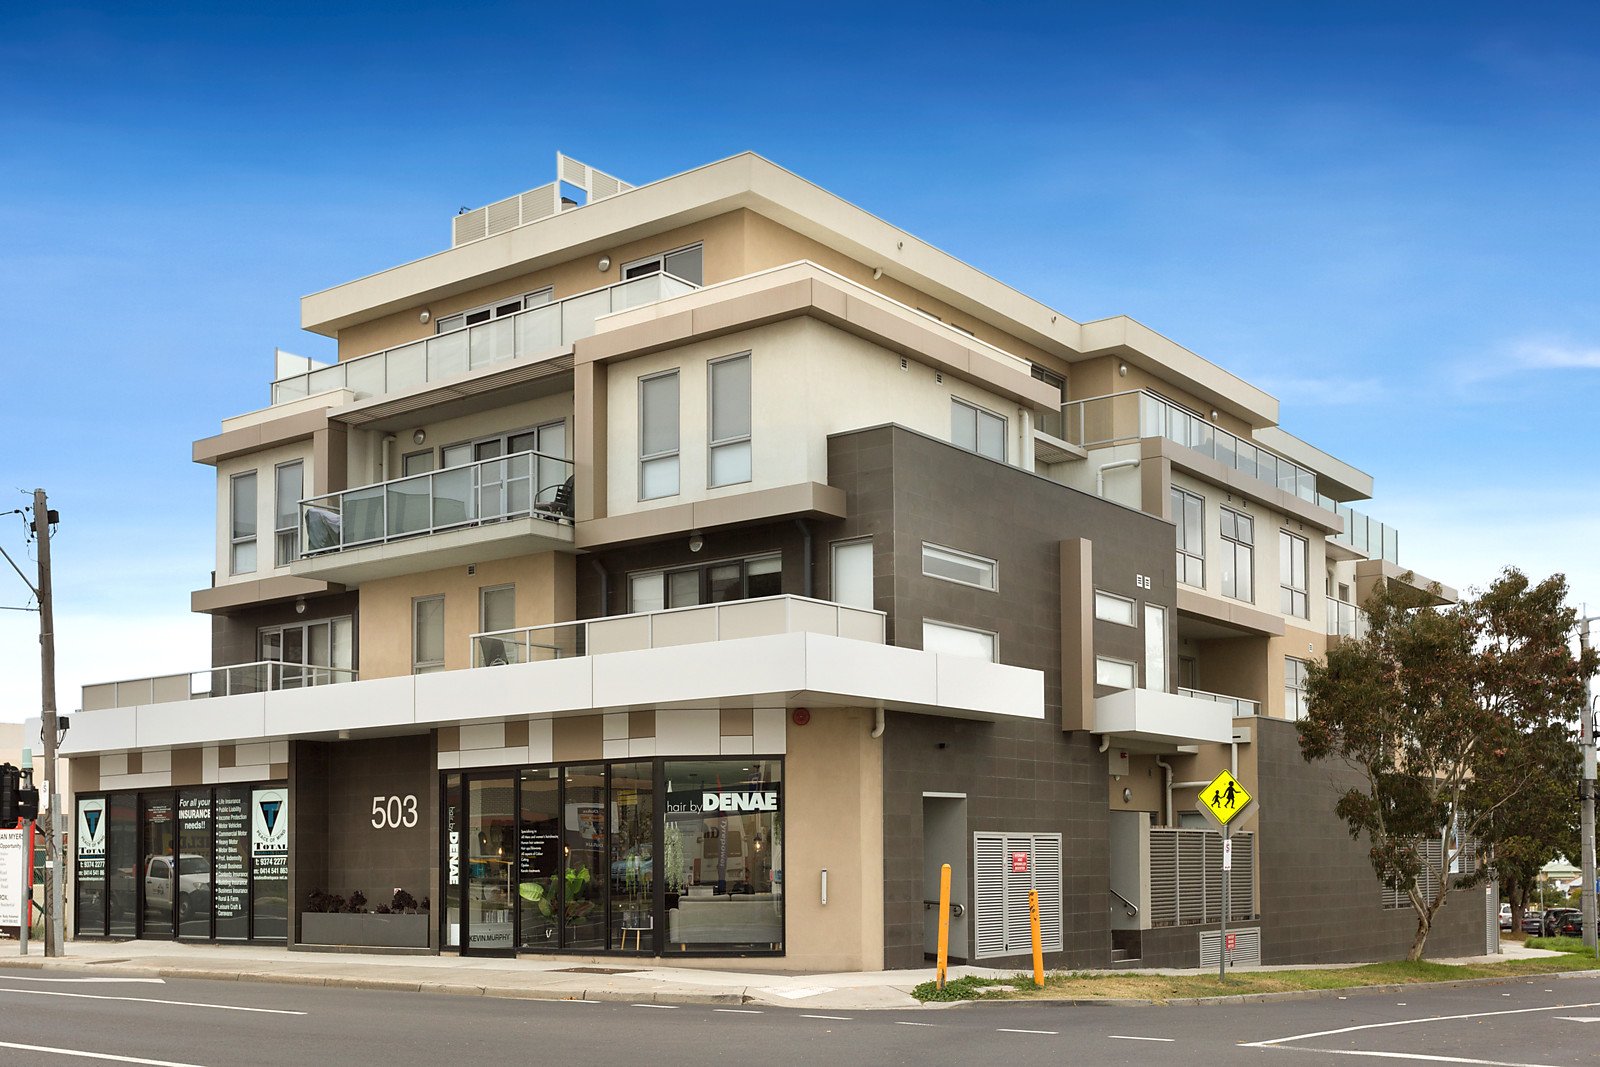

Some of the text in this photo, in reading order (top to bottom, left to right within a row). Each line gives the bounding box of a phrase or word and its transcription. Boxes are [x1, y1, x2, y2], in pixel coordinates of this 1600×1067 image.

[179, 799, 189, 807] For
[198, 800, 210, 808] your
[667, 792, 777, 814] hair by DENAE
[179, 809, 210, 819] INSURANCE
[372, 795, 418, 828] 503
[185, 821, 205, 830] needs!!
[256, 830, 268, 842] PEACE
[276, 829, 286, 840] MIND
[450, 832, 459, 884] DENAE
